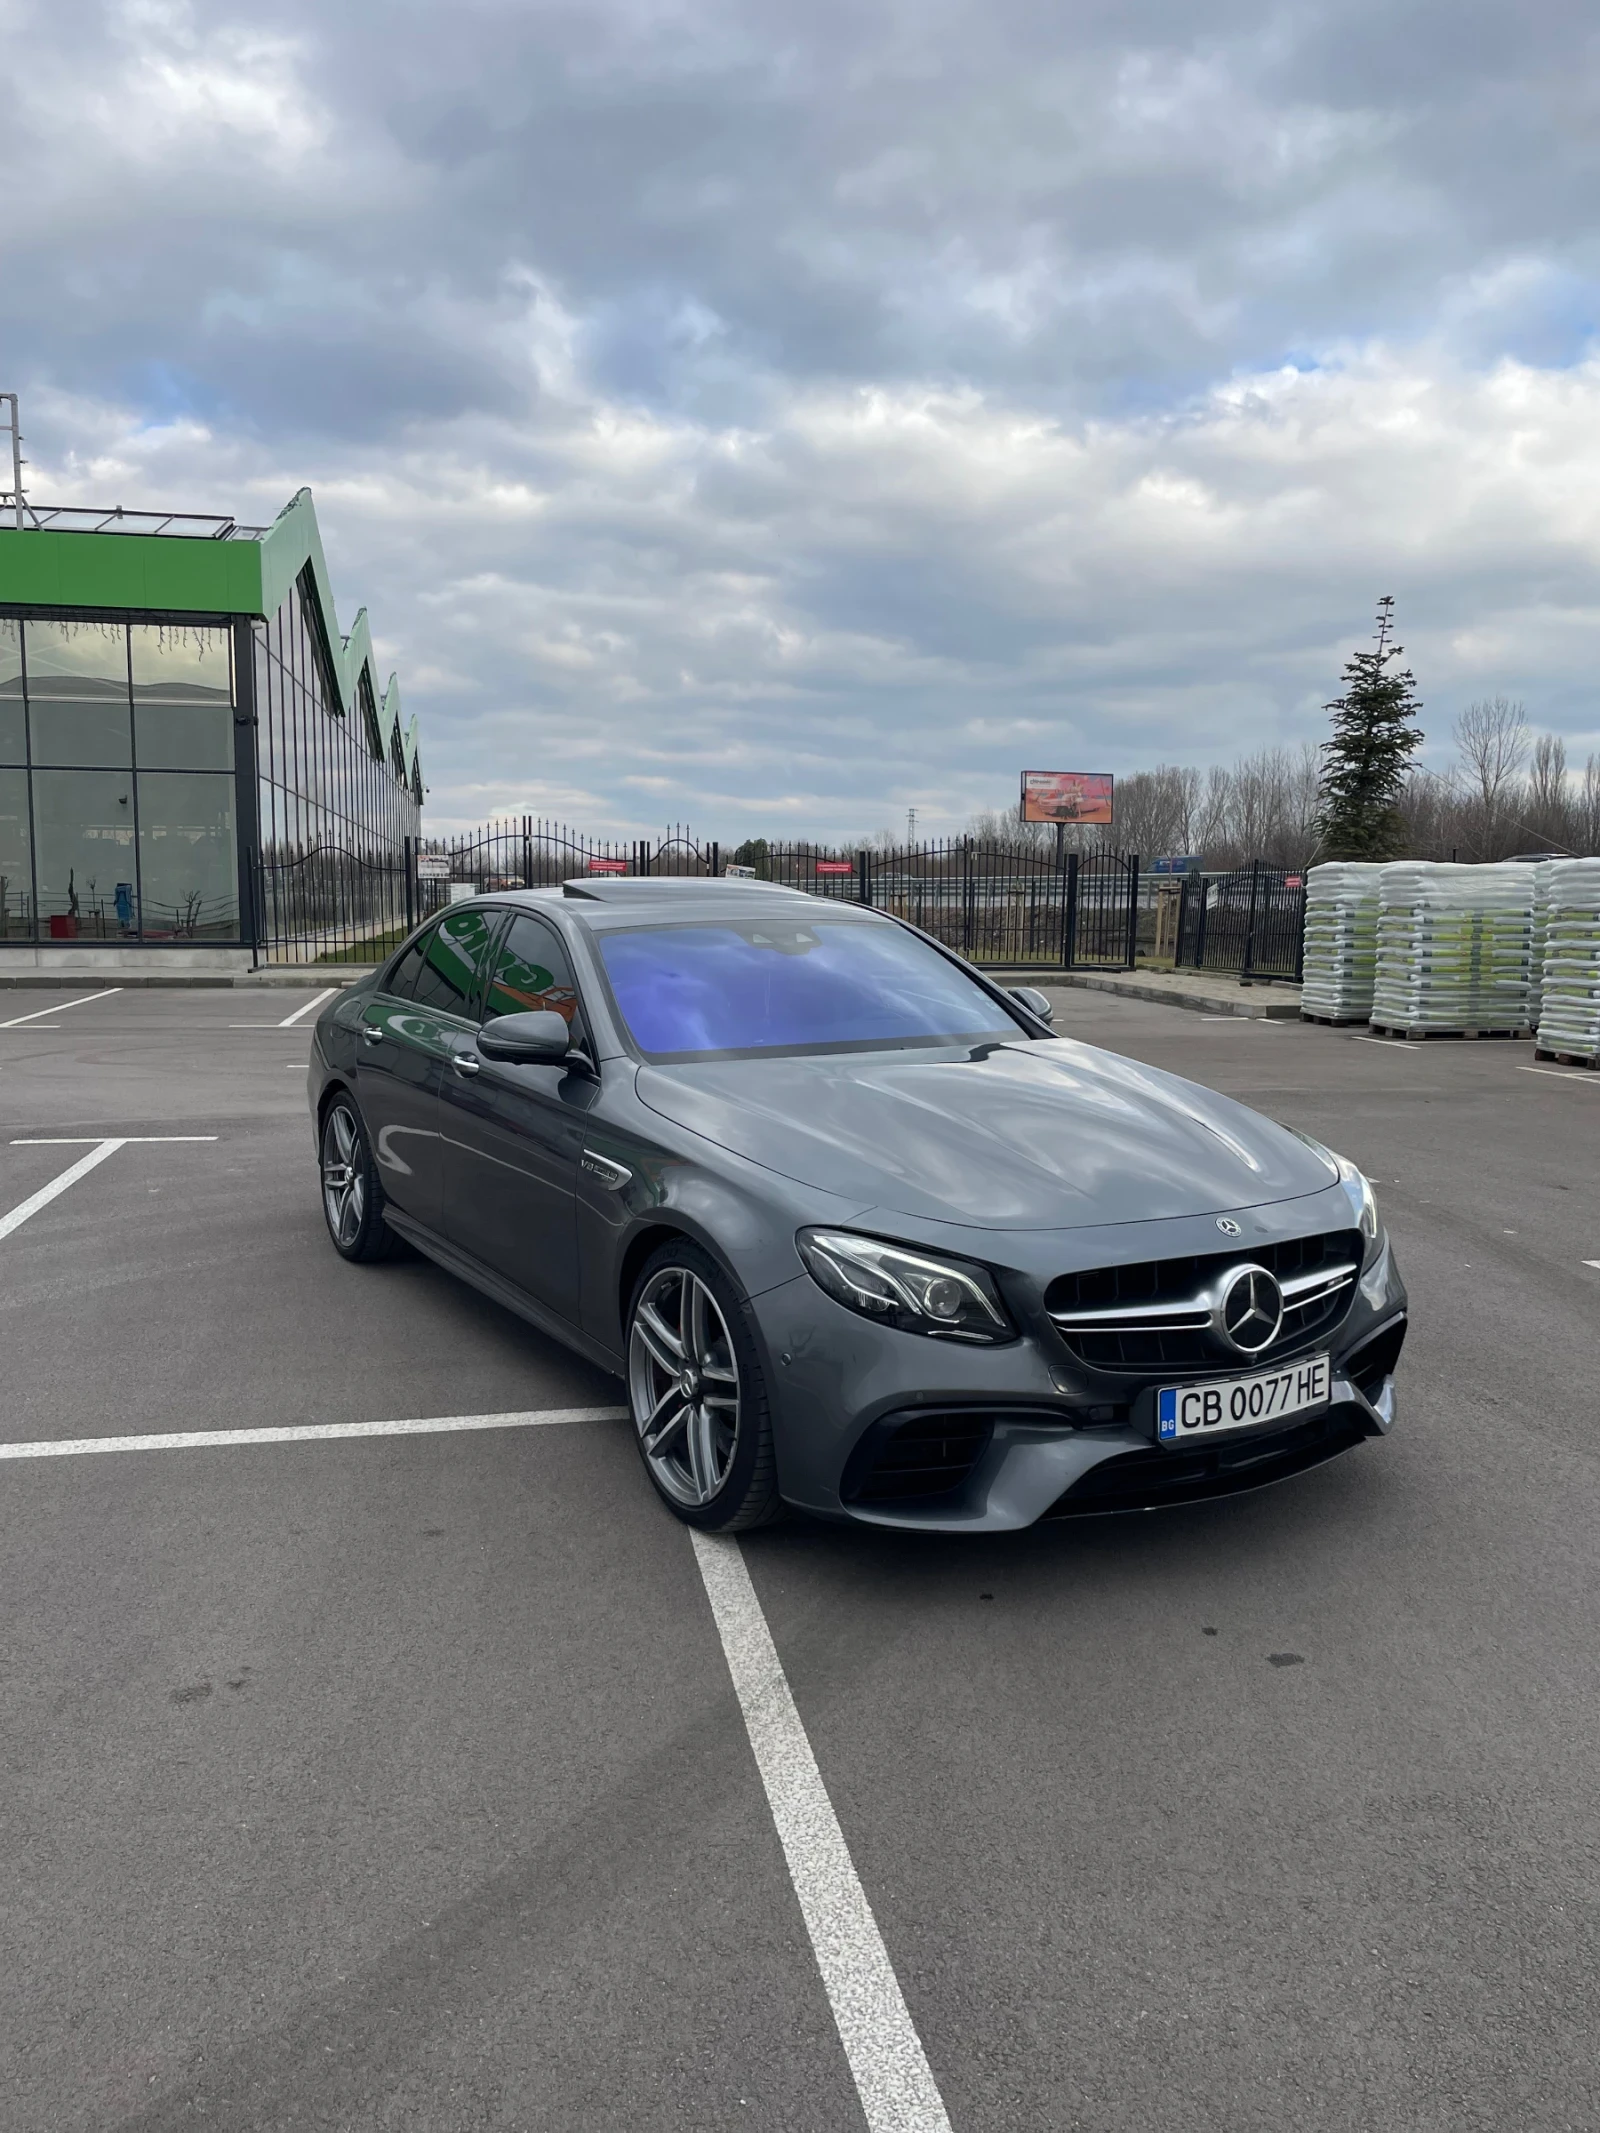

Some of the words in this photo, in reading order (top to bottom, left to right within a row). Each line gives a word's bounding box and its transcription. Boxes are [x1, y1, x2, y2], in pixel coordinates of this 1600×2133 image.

[1181, 1390, 1222, 1429] CB
[1230, 1373, 1293, 1421] 0077
[1297, 1363, 1325, 1405] HE
[1161, 1419, 1175, 1432] BG
